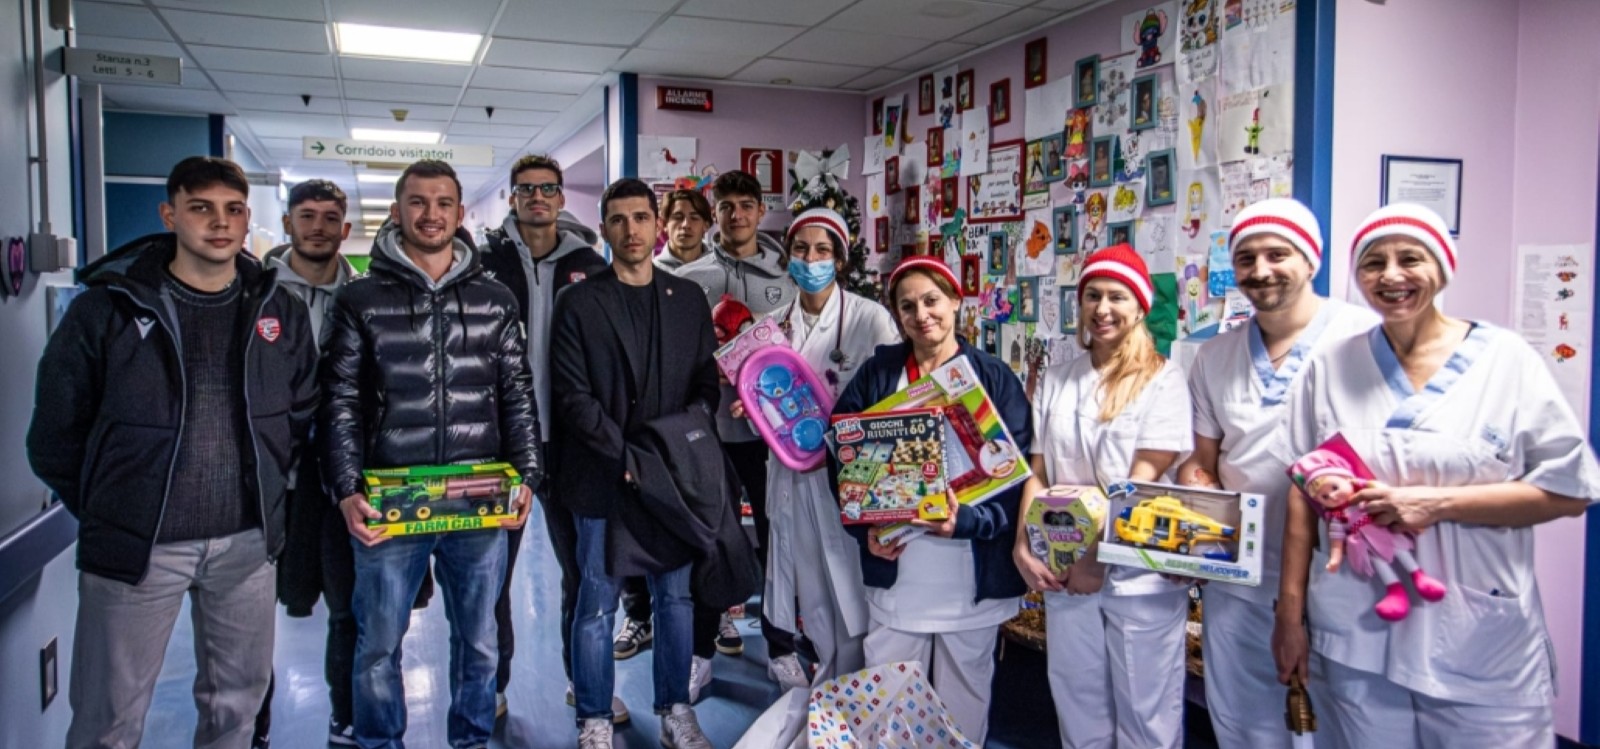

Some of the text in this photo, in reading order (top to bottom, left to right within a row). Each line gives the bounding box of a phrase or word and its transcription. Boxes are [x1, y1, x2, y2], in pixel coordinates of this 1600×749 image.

[96, 53, 150, 66] Stanza n.3
[93, 65, 117, 75] Letti
[126, 68, 132, 76] 5
[147, 70, 154, 78] 6
[666, 89, 708, 98] ALLARME
[665, 96, 708, 105] INCENDIO
[335, 143, 453, 160] Corridoio visitatori
[869, 419, 905, 430] GIOCHI
[910, 423, 926, 435] 60
[867, 427, 909, 439] RIUNITI
[404, 517, 484, 533] FARM CAR
